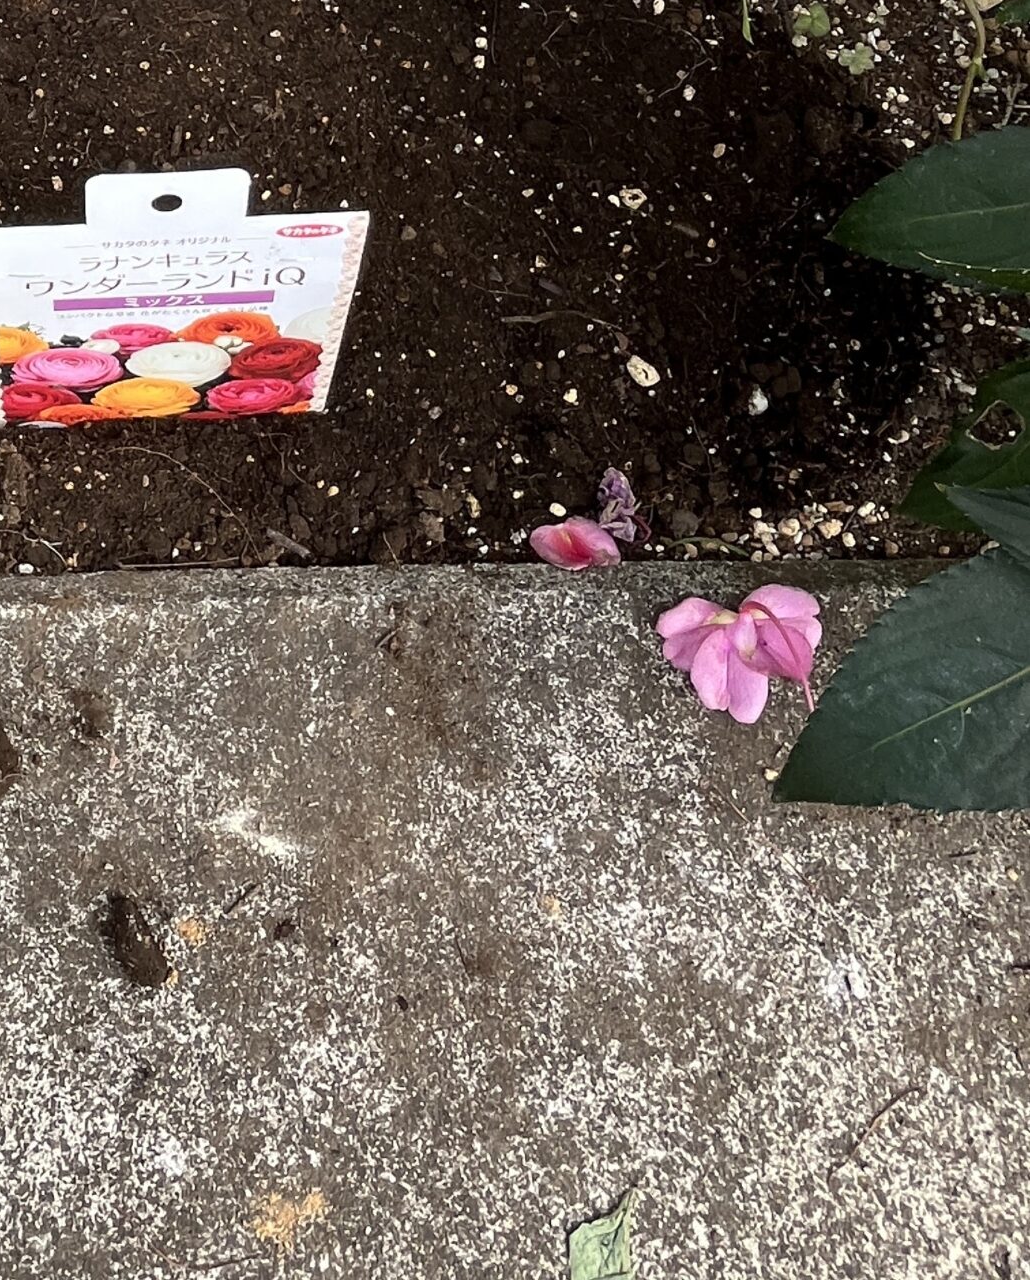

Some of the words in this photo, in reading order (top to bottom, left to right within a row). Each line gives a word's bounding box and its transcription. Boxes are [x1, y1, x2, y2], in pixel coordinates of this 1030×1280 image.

[177, 235, 232, 246] オリジナル
[78, 250, 253, 272] ラナンキュラス
[123, 294, 206, 308] ミックス
